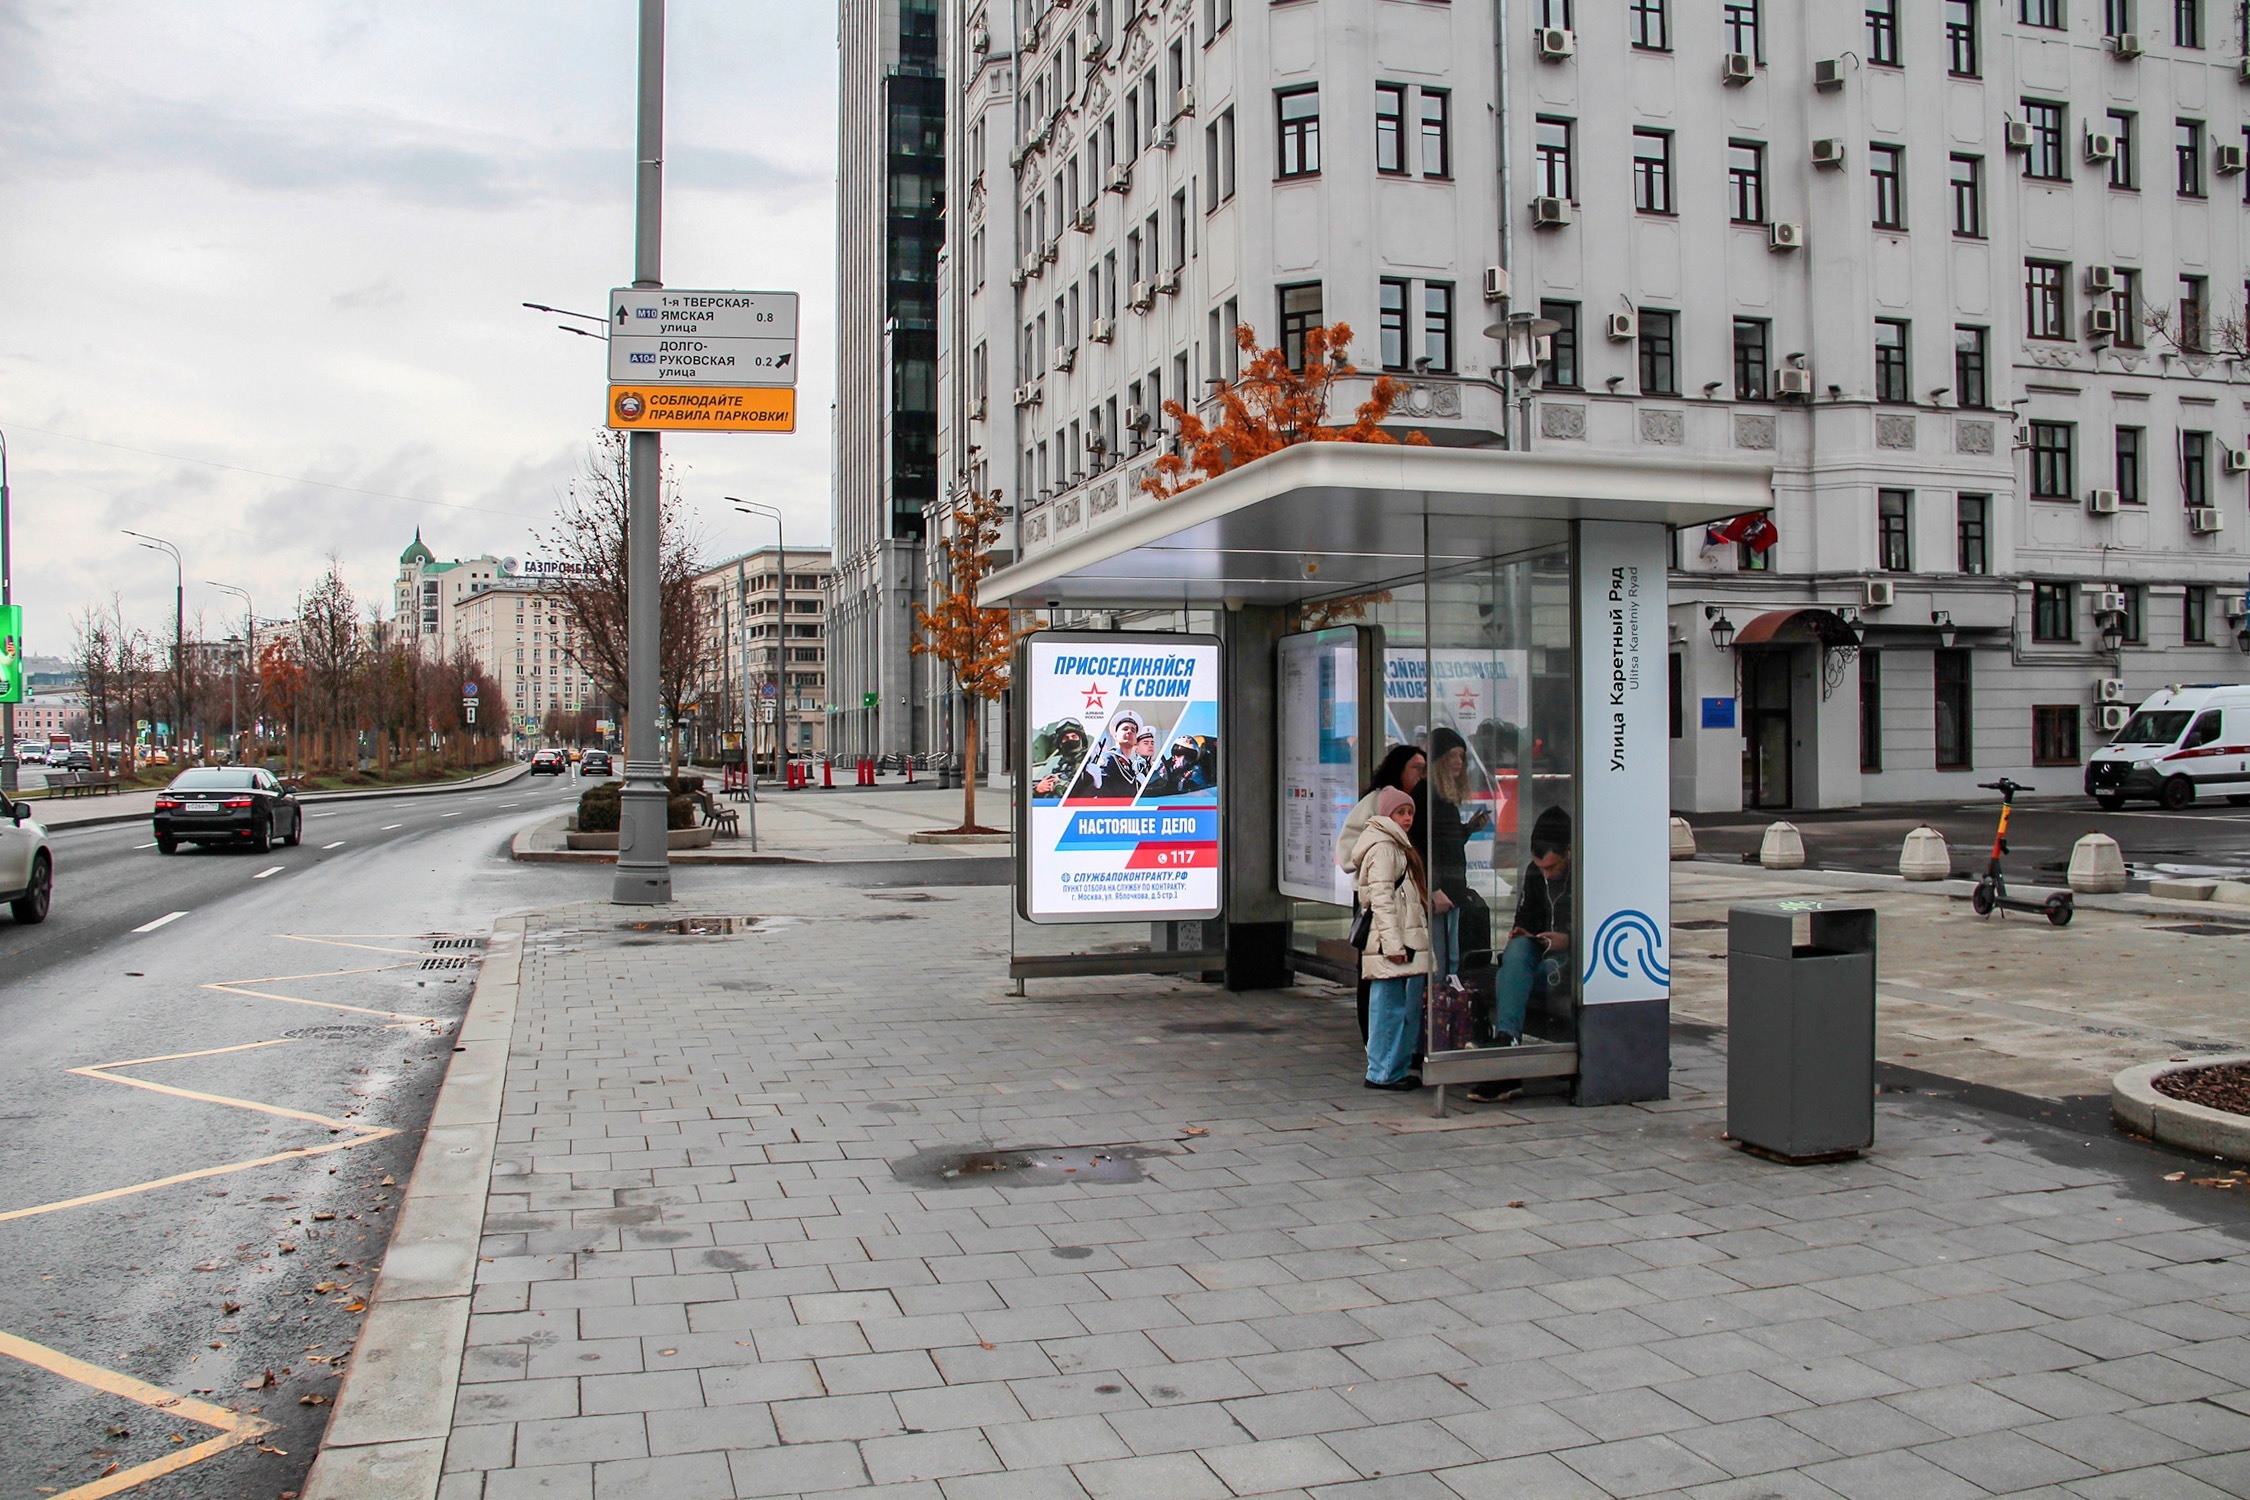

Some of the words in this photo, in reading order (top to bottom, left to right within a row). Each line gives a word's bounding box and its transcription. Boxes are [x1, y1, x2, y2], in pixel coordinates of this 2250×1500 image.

[661, 297, 680, 307] 1-я
[683, 297, 755, 308] ТВЕРСКАЯ-
[637, 309, 657, 318] М10
[661, 311, 714, 321] ЯМСКАЯ
[756, 313, 774, 322] 0.8
[660, 324, 698, 334] улица
[659, 341, 708, 353] ДОЛГО-
[659, 355, 735, 366] РУКОВСКАЯ
[755, 357, 772, 367] 0.2
[659, 368, 696, 378] улица
[649, 394, 743, 408] СОБЛЮДАЙТЕ
[649, 409, 710, 421] ПРАВИЛА
[714, 410, 789, 422] ПАРКОВКИ!
[1609, 566, 1624, 601] Ряд
[1628, 566, 1640, 597] Ryad
[1629, 601, 1640, 652] Karetniy
[1609, 609, 1626, 705] Каретный
[1054, 654, 1196, 678] ПРИСОЕДИНЯЙСЯ
[1630, 656, 1639, 690] Ulitsa
[1119, 678, 1132, 697] К
[1134, 678, 1191, 697] СВОИМ
[1610, 713, 1626, 772] Улица
[1078, 818, 1156, 836] НАСТОЯЩЕЕ
[1161, 817, 1196, 835] ДЕЛО
[1171, 850, 1196, 863] 117
[1073, 871, 1188, 883] СЛУЖБАПОКОНТРАКТУ.РФ
[1063, 884, 1083, 893] ПУНКТ
[1084, 884, 1107, 892] ОТБОРА
[1108, 883, 1116, 892] НА
[1116, 883, 1142, 892] СЛУЖБУ
[1142, 883, 1151, 891] ПО
[1151, 882, 1187, 891] КОНТРАКТУ:
[1078, 893, 1104, 902] Москва,
